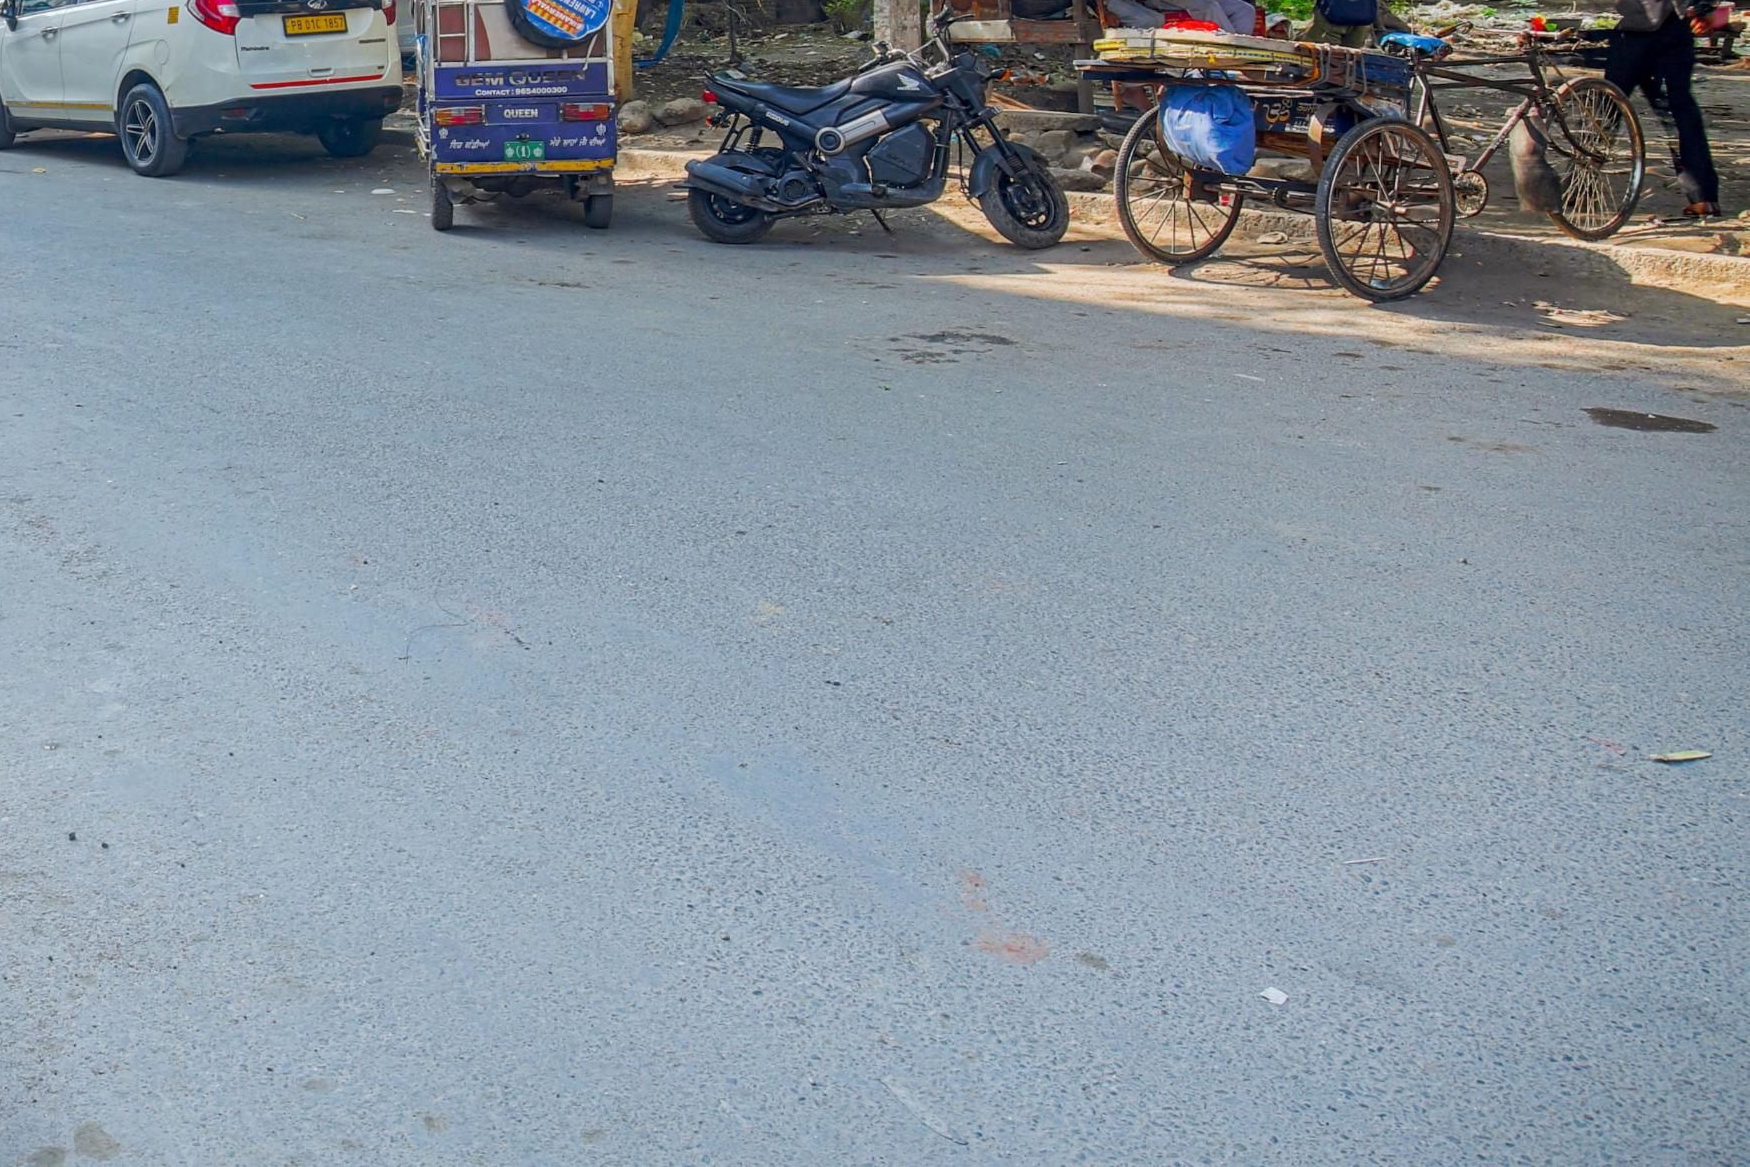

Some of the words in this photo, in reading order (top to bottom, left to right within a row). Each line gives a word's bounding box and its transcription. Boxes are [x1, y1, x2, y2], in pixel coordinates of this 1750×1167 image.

[291, 20, 303, 31] PB
[306, 18, 321, 31] 01C
[324, 17, 344, 29] 1857
[455, 71, 504, 87] GEM
[509, 69, 586, 86] QUEEN
[503, 108, 539, 119] QUEEN
